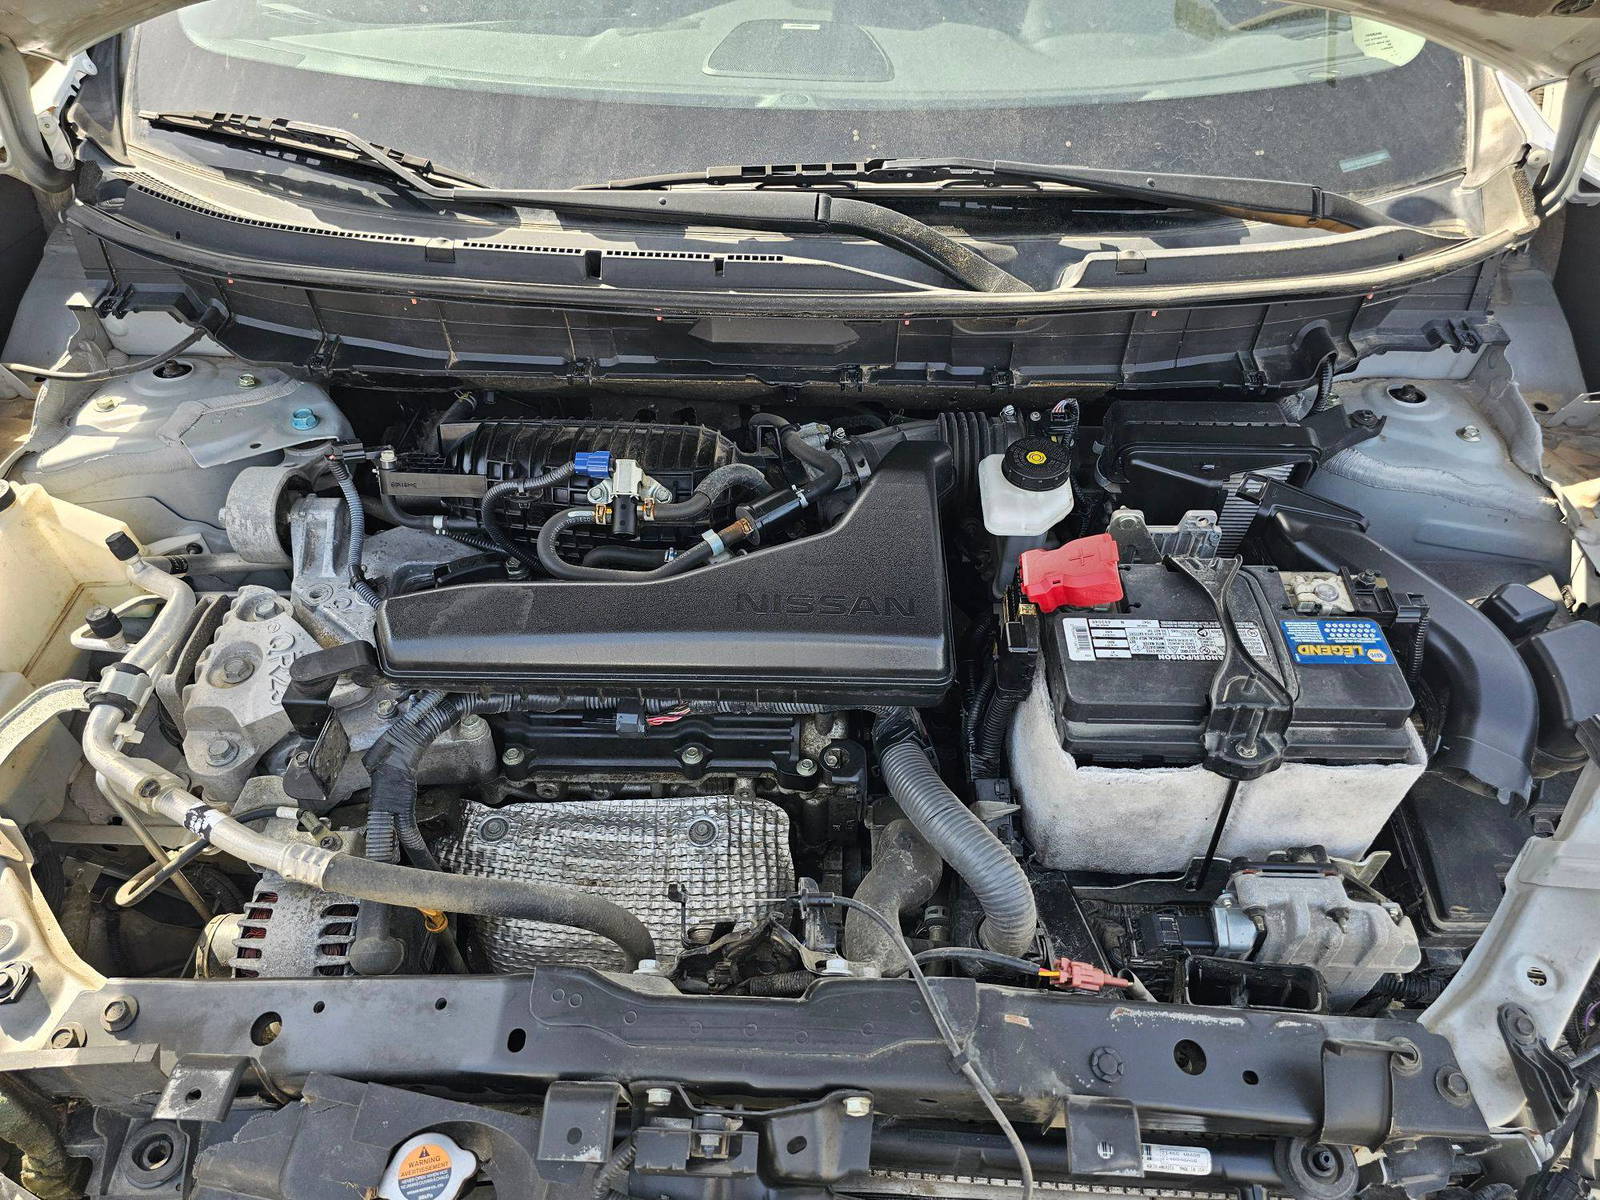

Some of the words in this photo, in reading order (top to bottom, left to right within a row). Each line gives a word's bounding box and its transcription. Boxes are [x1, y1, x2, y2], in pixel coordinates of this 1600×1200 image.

[736, 593, 916, 617] NISSAN
[1298, 645, 1364, 656] LEGEND
[408, 1155, 441, 1168] WARNING
[400, 1161, 449, 1177] AVERTISSEMENT
